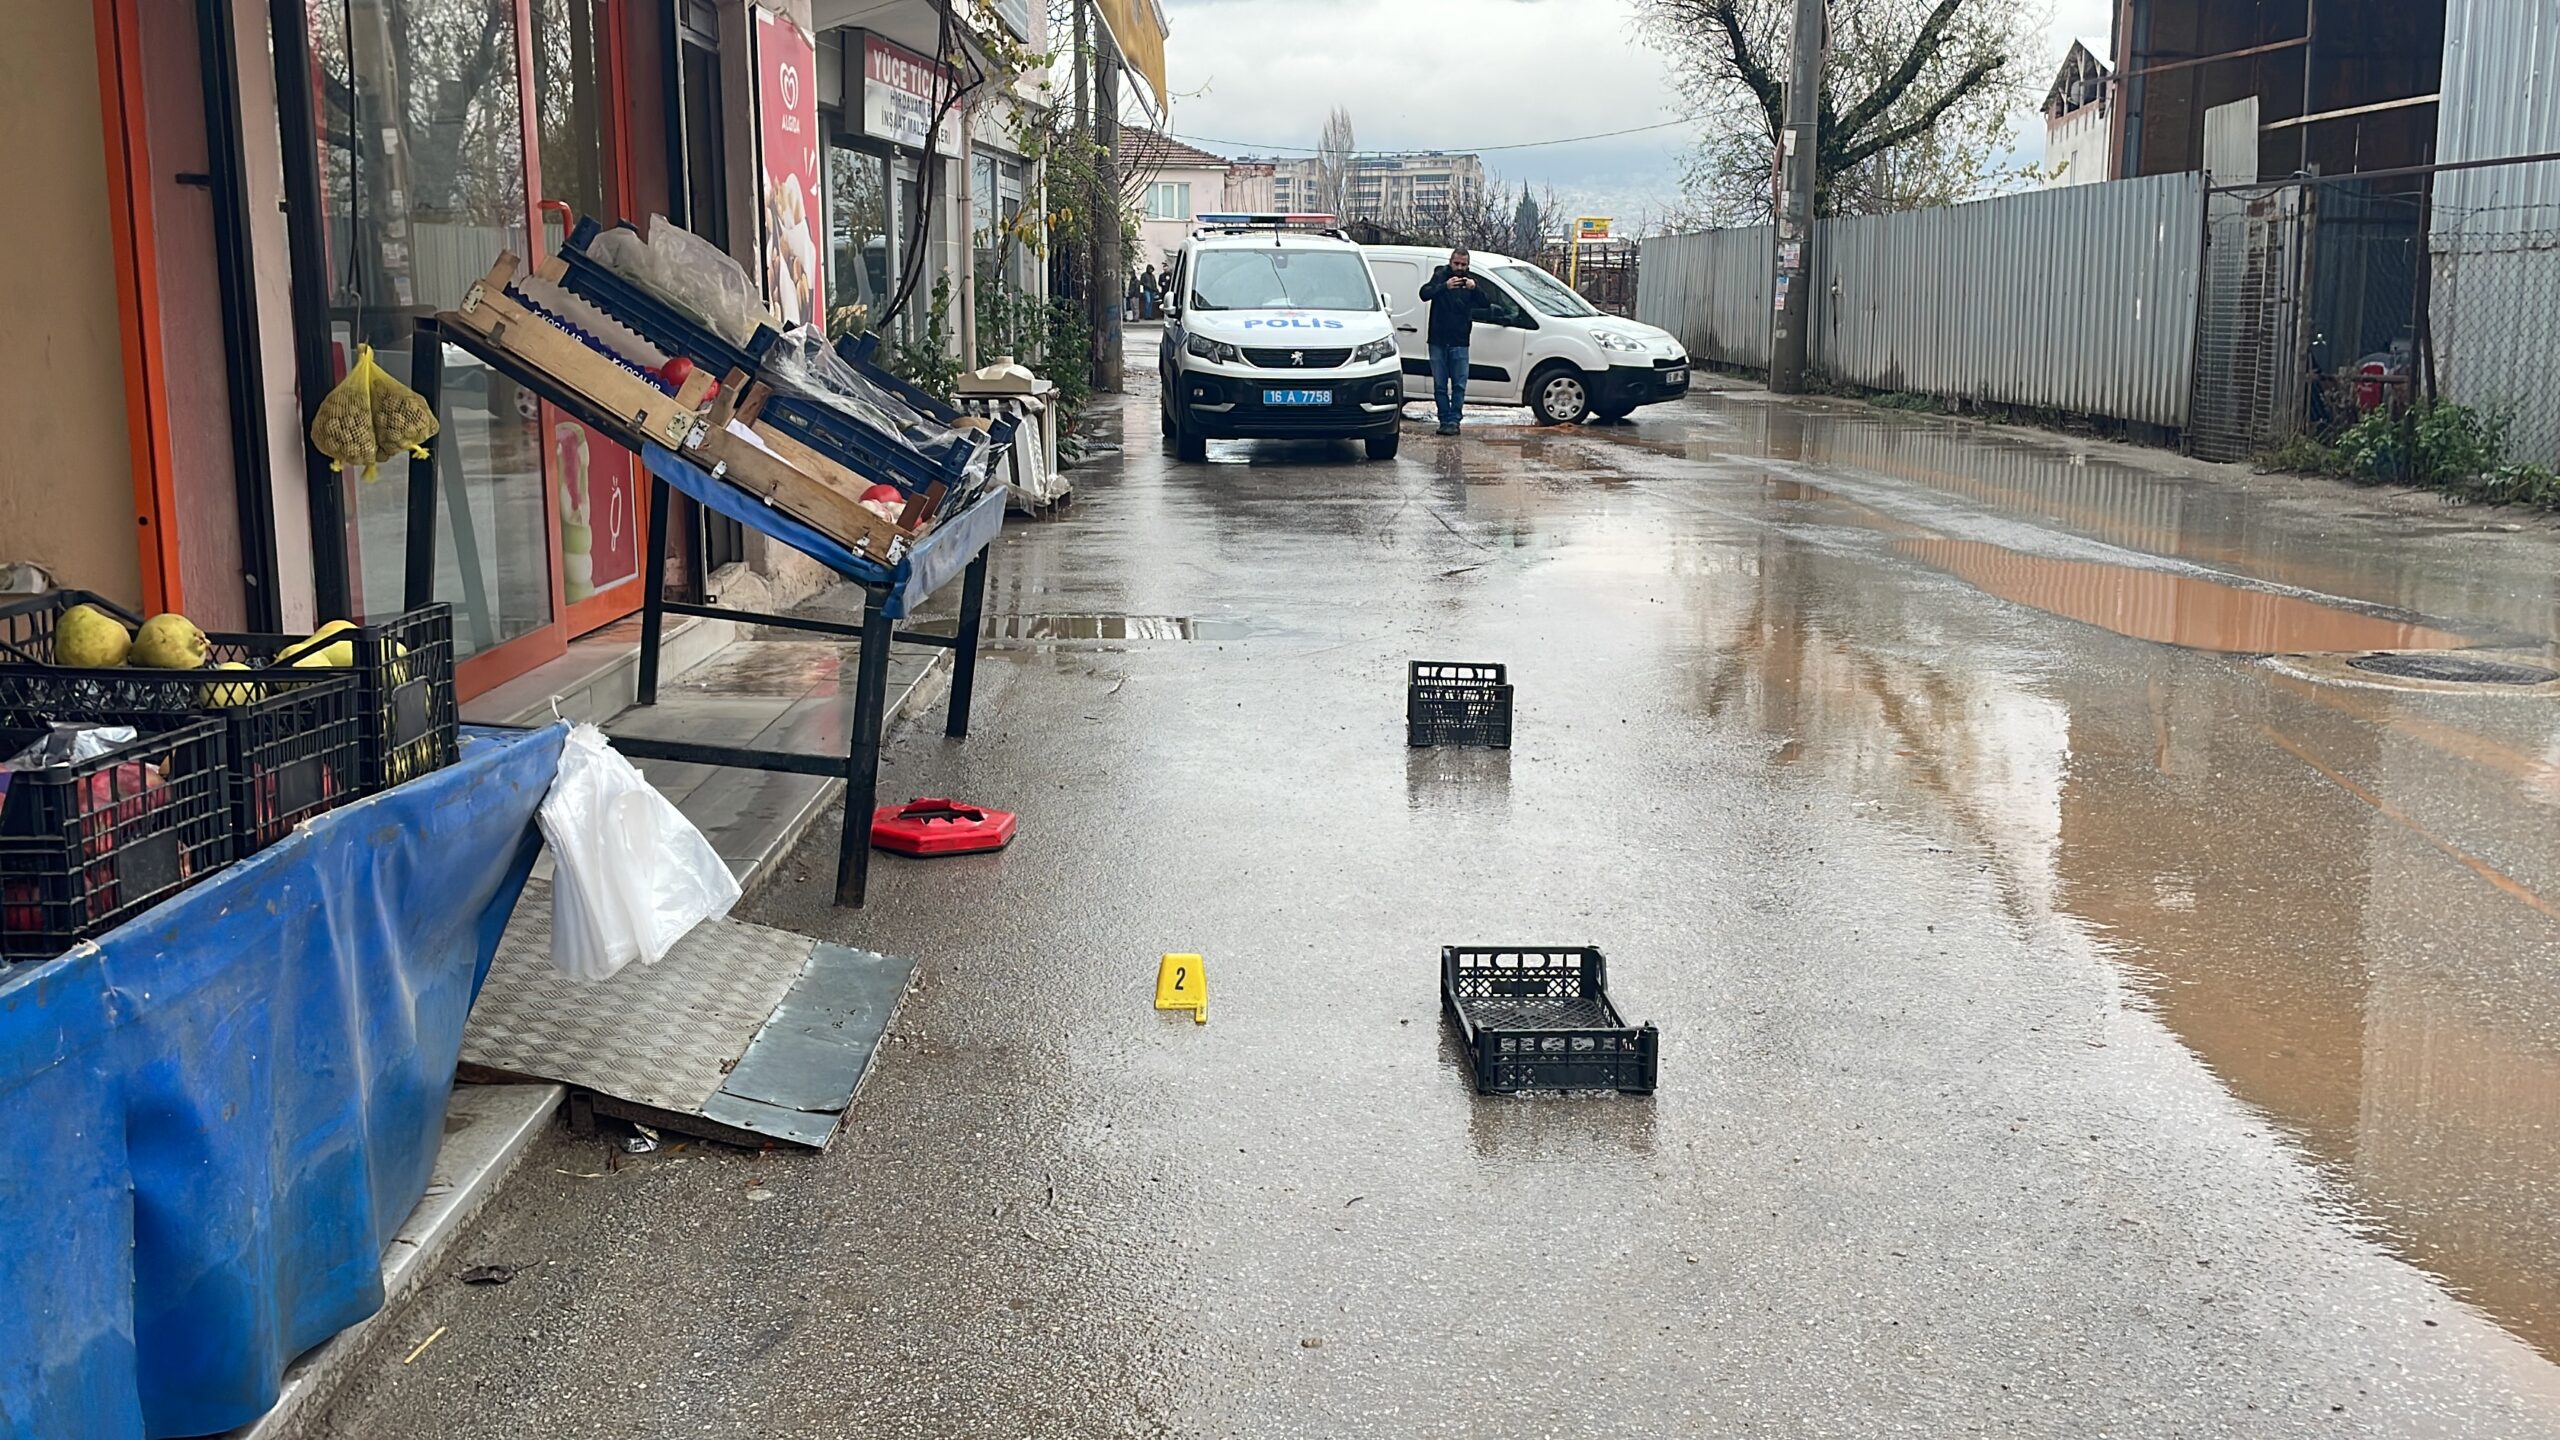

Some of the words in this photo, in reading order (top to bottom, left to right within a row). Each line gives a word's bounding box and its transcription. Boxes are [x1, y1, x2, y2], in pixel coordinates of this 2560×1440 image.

[873, 47, 907, 89] YÜCE
[908, 117, 951, 144] MALZEERİ
[1244, 318, 1344, 329] POLİS
[1270, 391, 1282, 403] 16
[1287, 391, 1296, 403] A
[1302, 391, 1330, 403] 7758
[1174, 966, 1186, 991] 2
